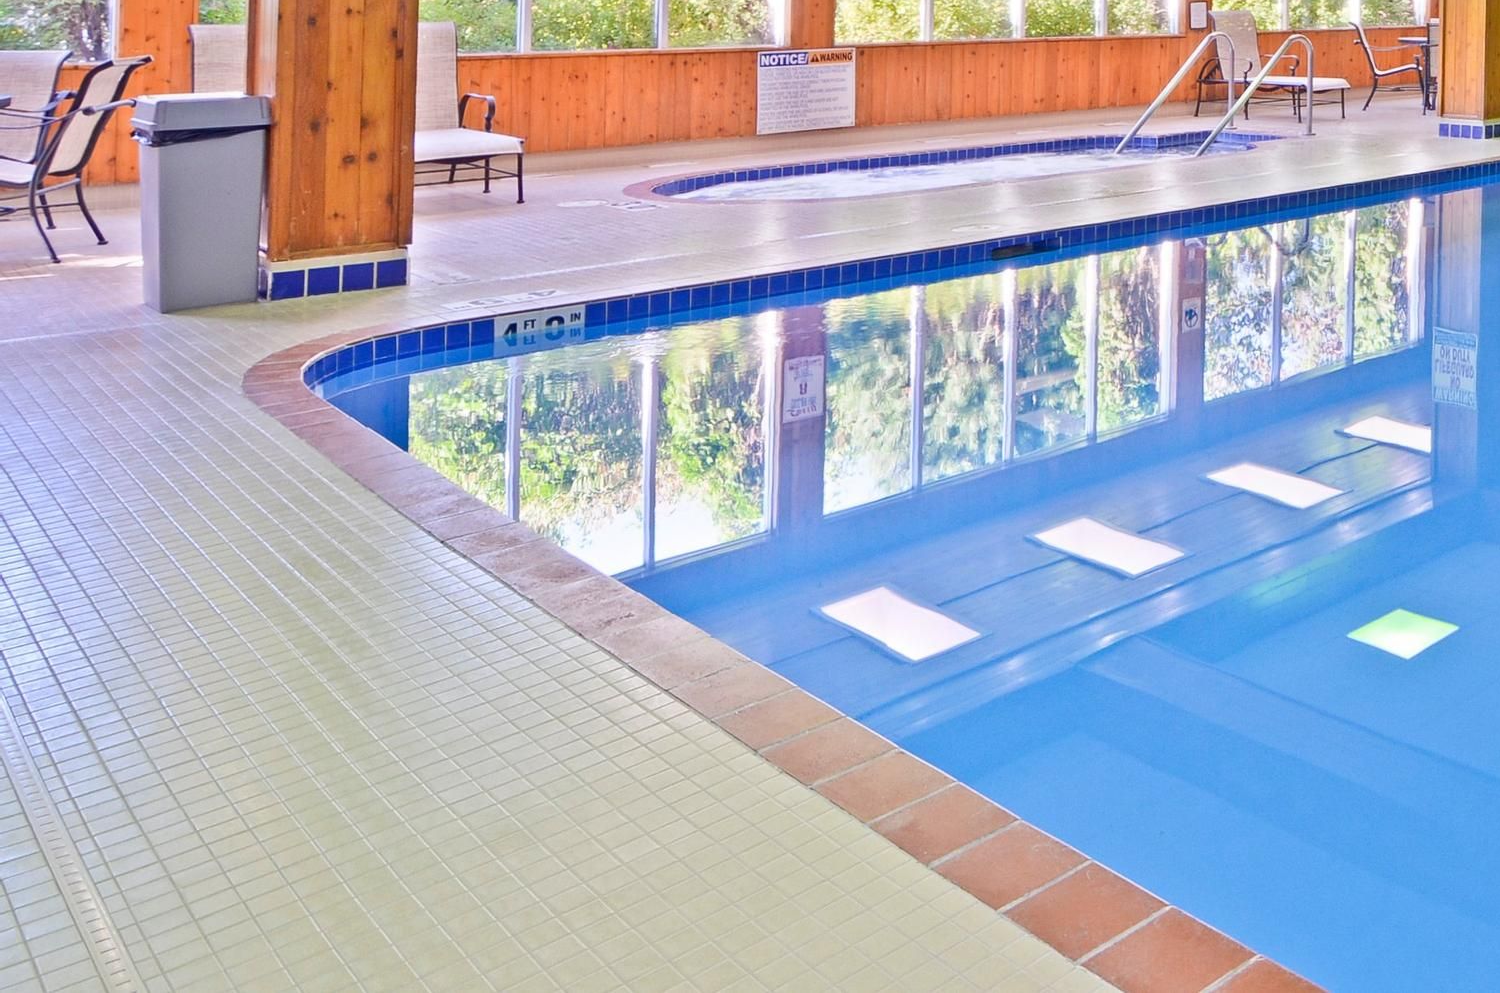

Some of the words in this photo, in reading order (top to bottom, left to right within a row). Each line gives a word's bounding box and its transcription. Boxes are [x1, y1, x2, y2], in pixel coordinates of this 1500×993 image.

[819, 52, 853, 62] WARNING
[523, 318, 537, 330] FT
[570, 312, 582, 323] IN
